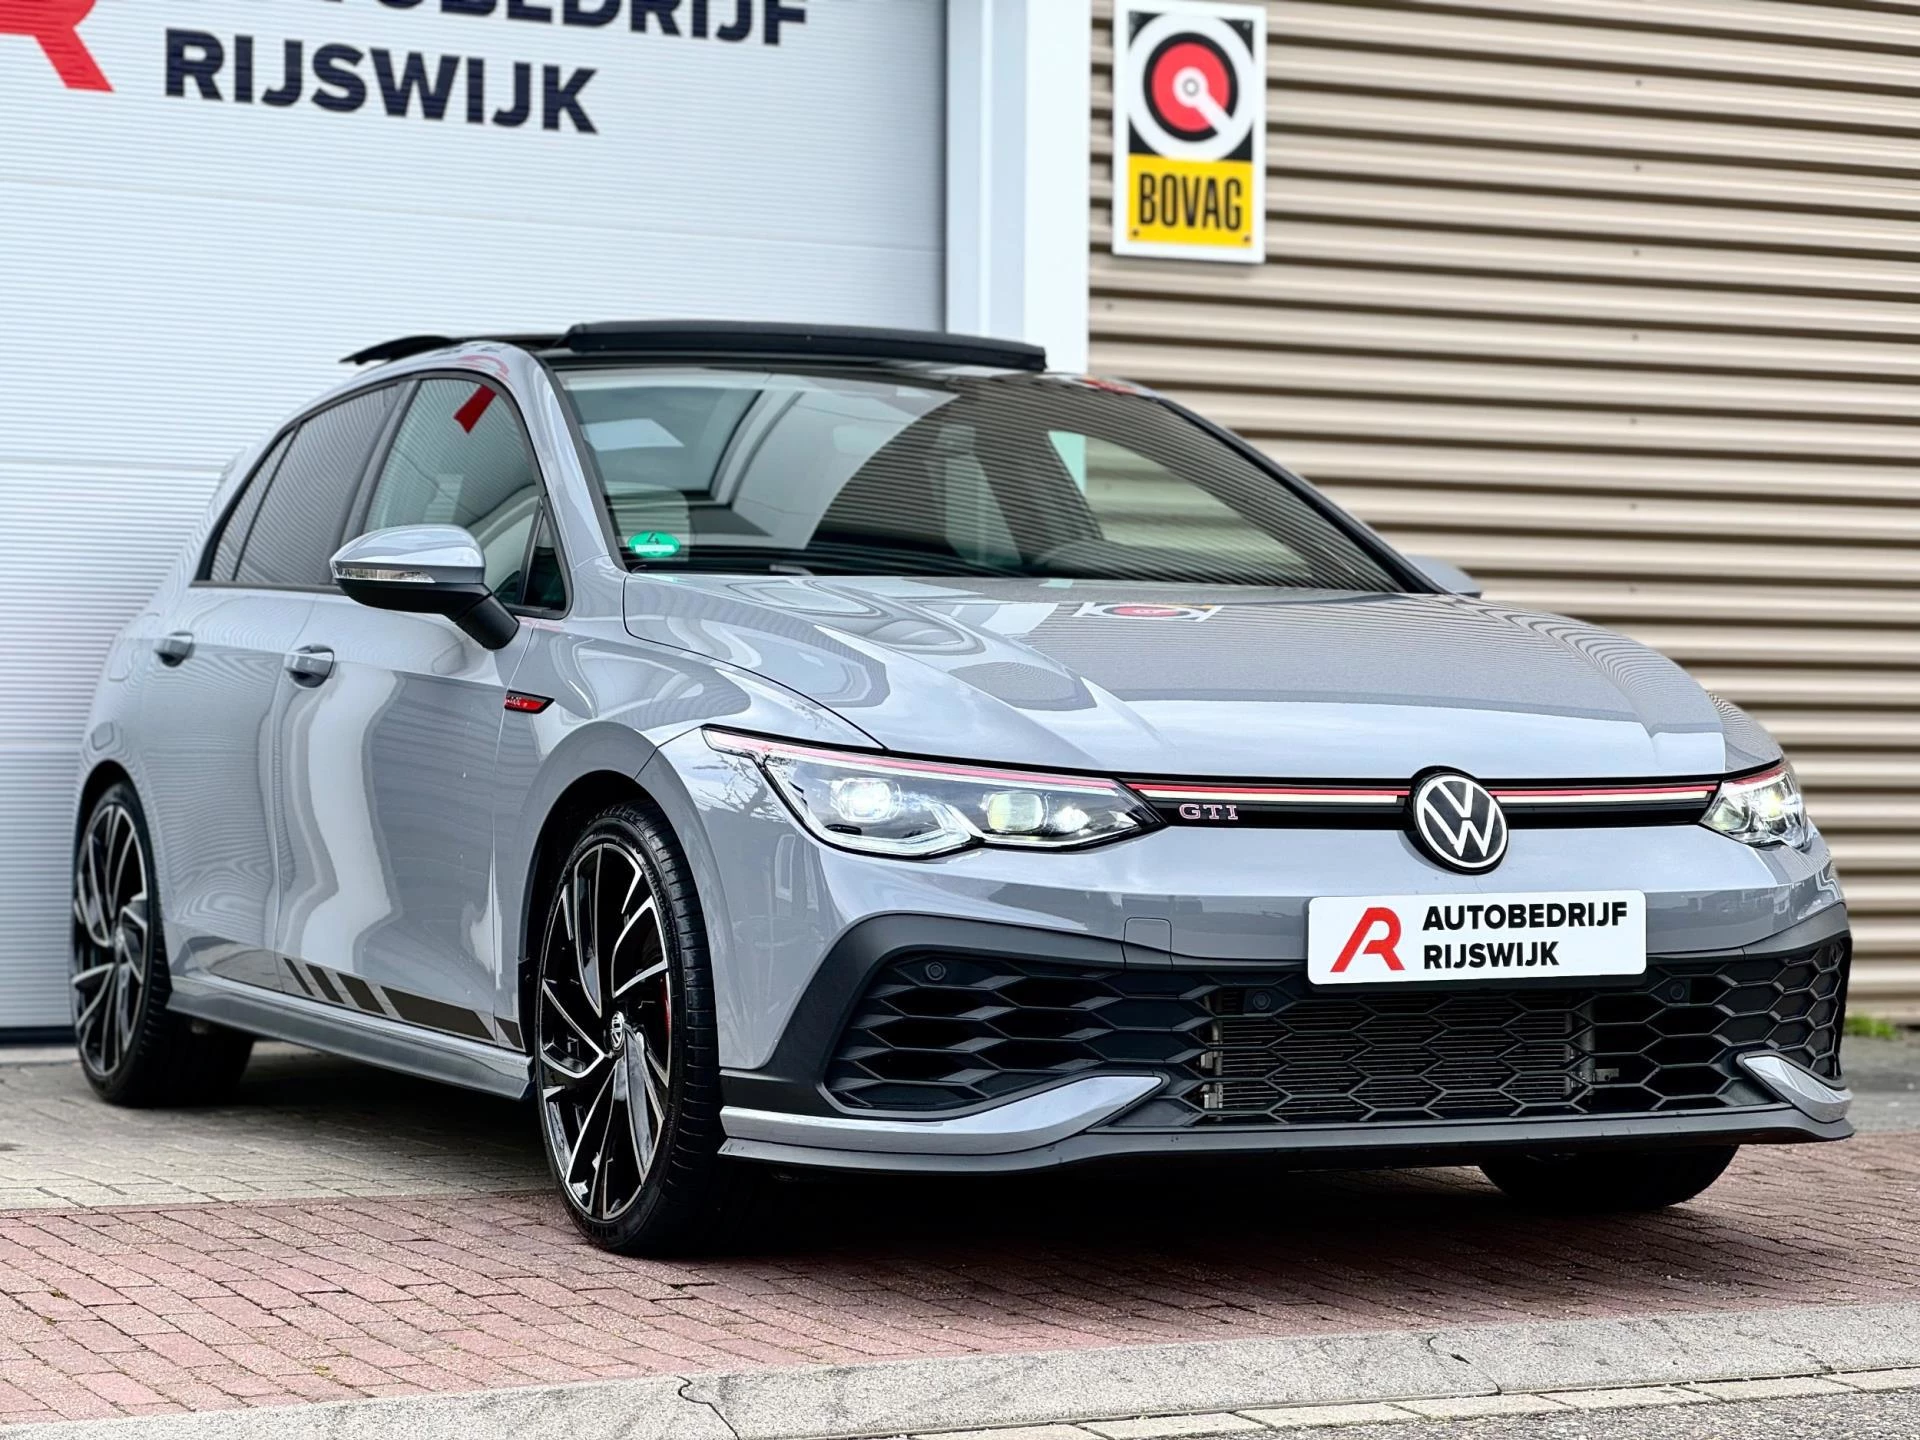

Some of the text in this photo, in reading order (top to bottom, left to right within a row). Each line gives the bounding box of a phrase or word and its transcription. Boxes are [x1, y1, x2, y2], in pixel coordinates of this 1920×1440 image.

[165, 28, 598, 134] RIJSWIJK
[1139, 172, 1243, 231] BOVAG
[1178, 803, 1239, 820] GTI
[1422, 901, 1628, 931] AUTOBEDRIJF
[1423, 941, 1560, 970] RIJSWIJK
